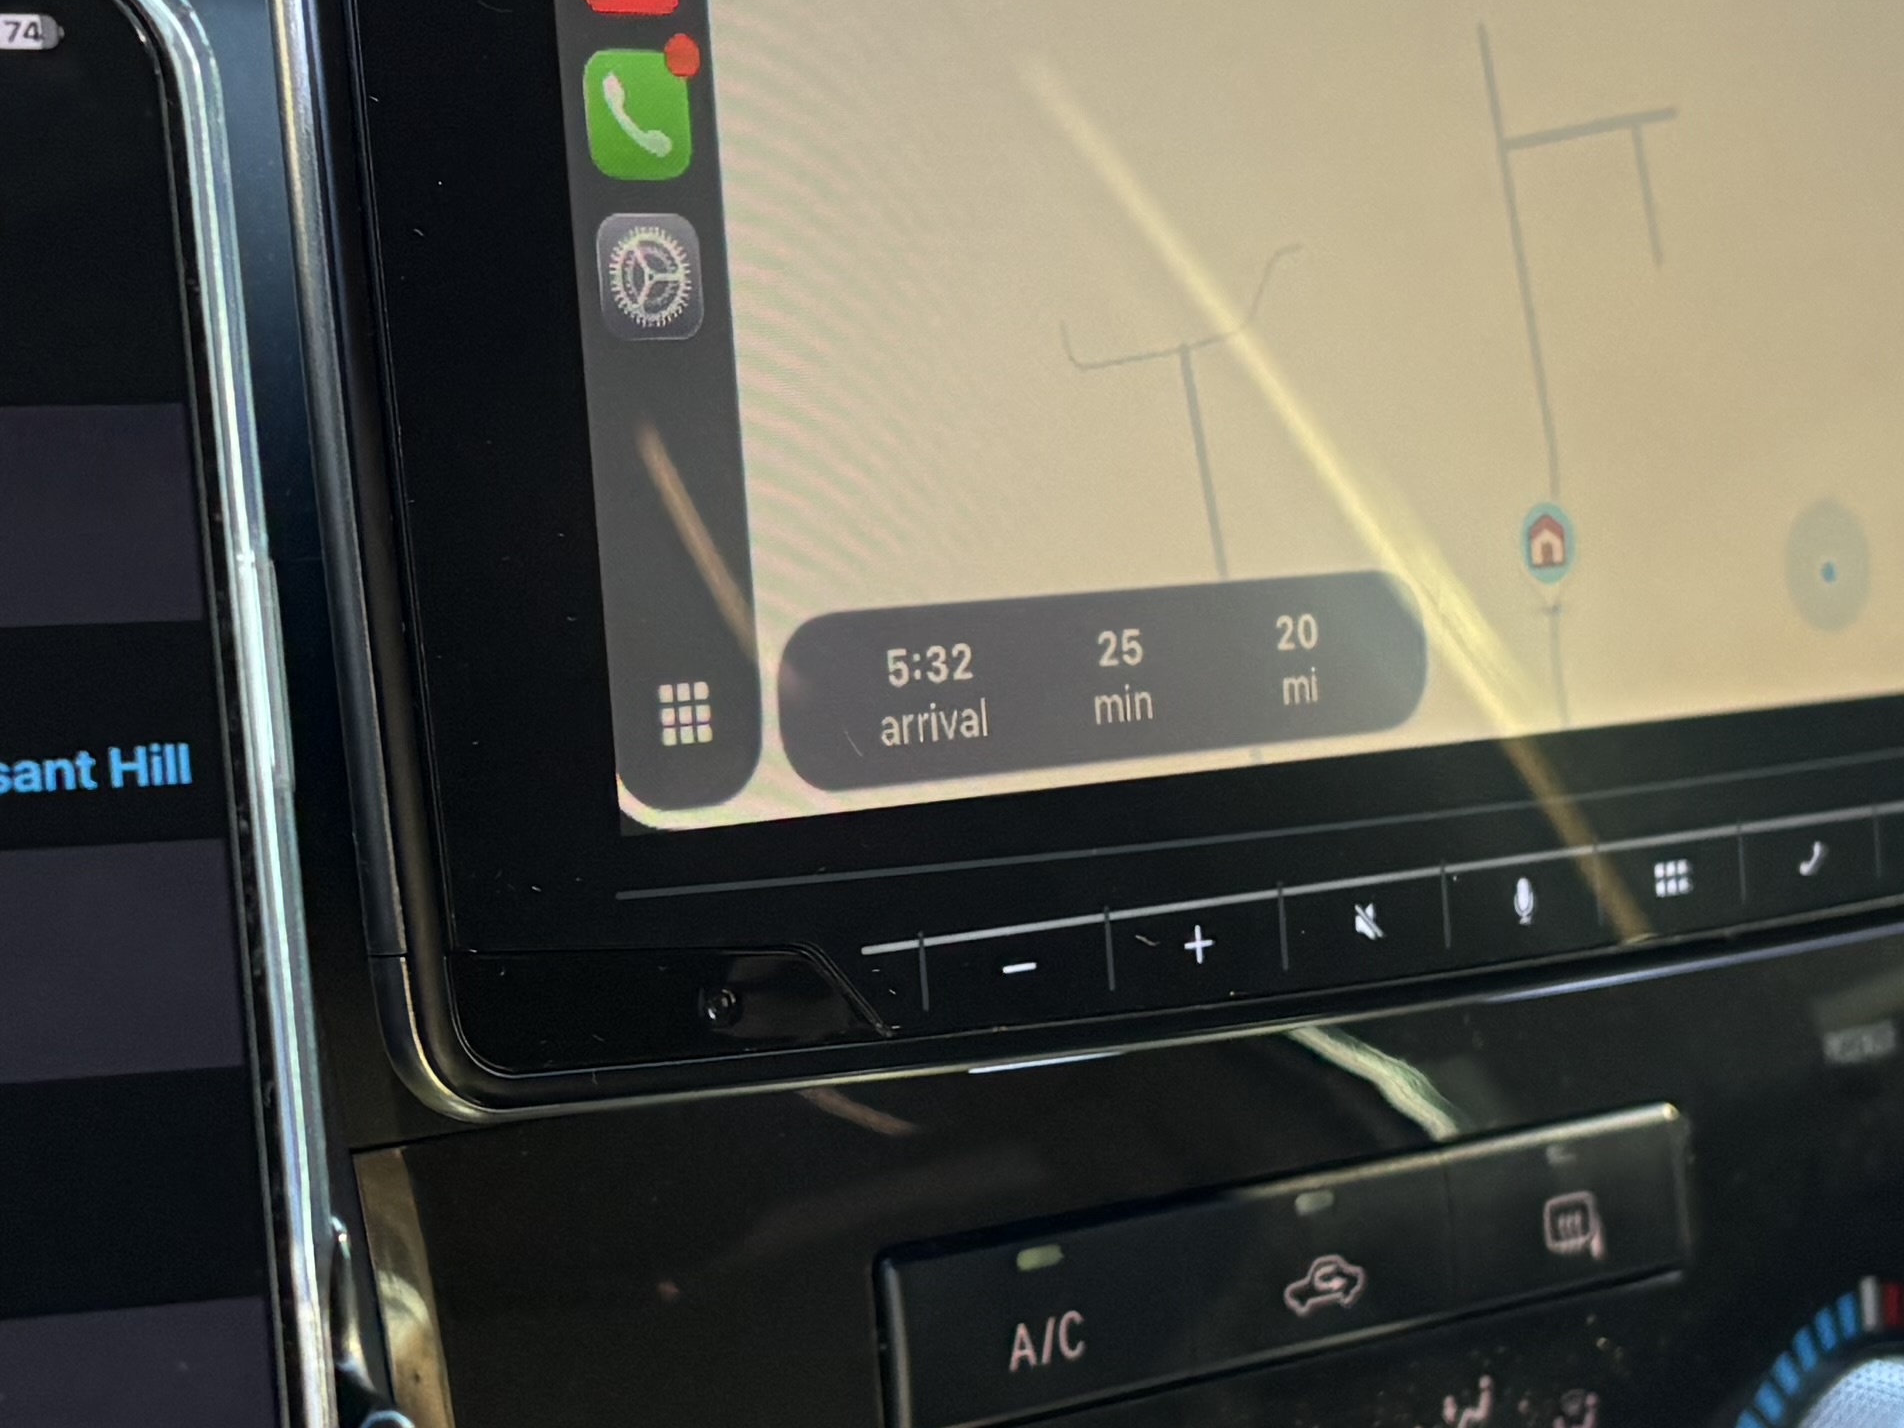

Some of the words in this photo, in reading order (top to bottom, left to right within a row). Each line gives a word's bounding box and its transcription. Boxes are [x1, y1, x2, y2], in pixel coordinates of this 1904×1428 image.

[2, 19, 46, 44] 74
[1097, 628, 1144, 667] 25
[1275, 613, 1319, 651] 20
[886, 642, 974, 688] 5:32
[1282, 666, 1319, 706] mi
[880, 697, 988, 747] arrival
[1094, 683, 1154, 725] min
[108, 743, 192, 788] Hill
[1009, 1310, 1084, 1371] A/C
